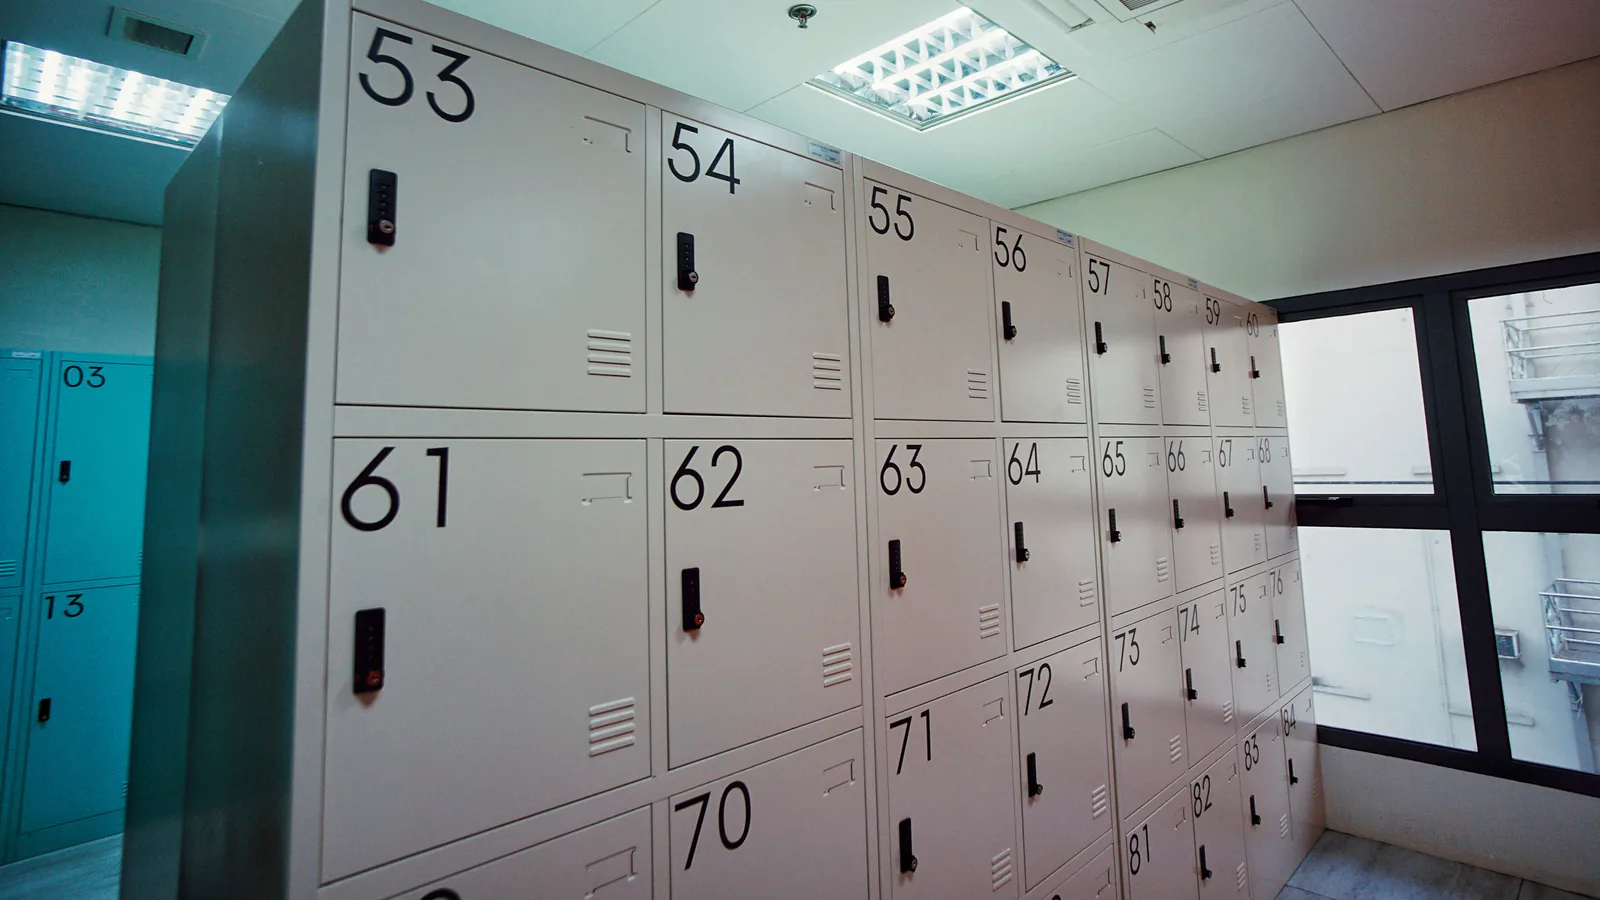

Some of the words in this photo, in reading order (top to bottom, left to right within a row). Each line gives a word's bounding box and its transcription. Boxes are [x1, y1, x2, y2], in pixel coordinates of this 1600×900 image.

[359, 28, 474, 122] 53
[668, 122, 740, 194] 54
[869, 186, 914, 241] 55
[995, 227, 1026, 272] 56
[1089, 258, 1110, 295] 57
[1154, 279, 1172, 312] 58
[1205, 297, 1221, 326] 59
[1246, 312, 1259, 337] 60
[64, 366, 105, 388] 03
[1008, 443, 1040, 485] 64
[1103, 441, 1125, 477] 65
[1168, 441, 1184, 472] 66
[1219, 439, 1232, 468] 67
[1259, 438, 1271, 463] 68
[341, 447, 448, 531] 61
[671, 445, 744, 509] 62
[880, 445, 925, 495] 63
[1230, 583, 1247, 617] 75
[1269, 569, 1284, 598] 76
[45, 594, 83, 619] 13
[1179, 604, 1201, 642] 74
[1115, 628, 1139, 672] 73
[1020, 663, 1053, 715] 72
[1283, 704, 1297, 737] 84
[890, 709, 931, 775] 71
[1244, 734, 1260, 771] 83
[1194, 775, 1212, 818] 82
[675, 781, 751, 870] 70
[1130, 824, 1149, 875] 81
